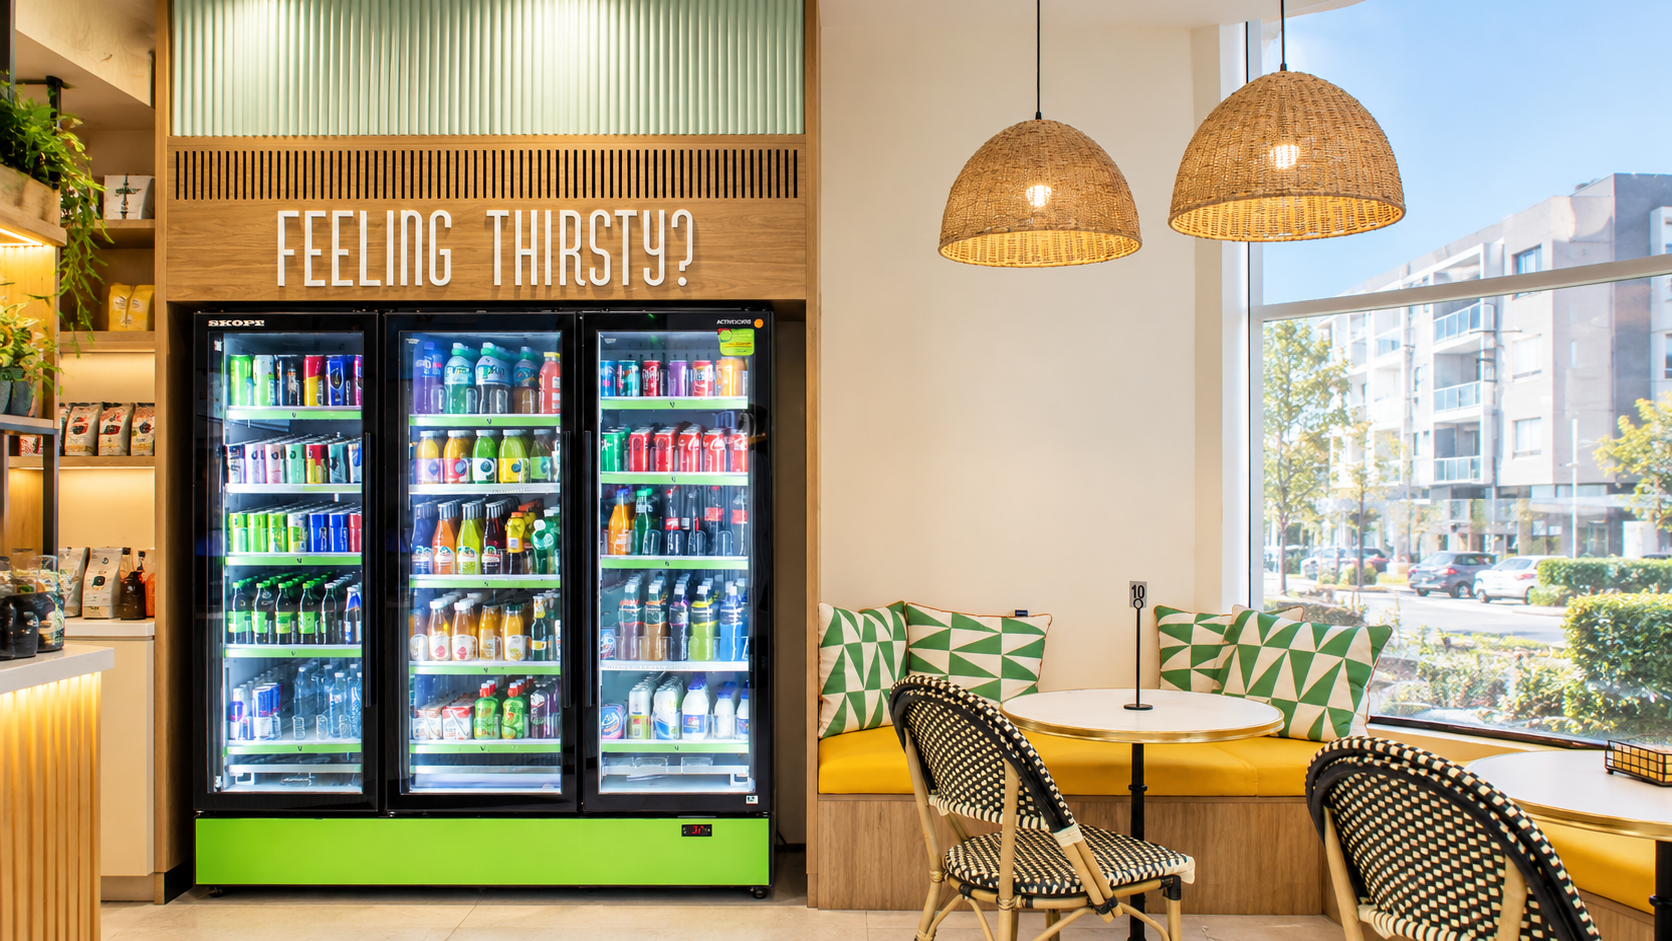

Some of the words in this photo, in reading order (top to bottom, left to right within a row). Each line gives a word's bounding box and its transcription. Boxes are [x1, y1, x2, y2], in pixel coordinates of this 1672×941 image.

[277, 209, 452, 287] FEELING
[486, 209, 693, 287] THIRSTY?
[1131, 584, 1145, 599] 10
